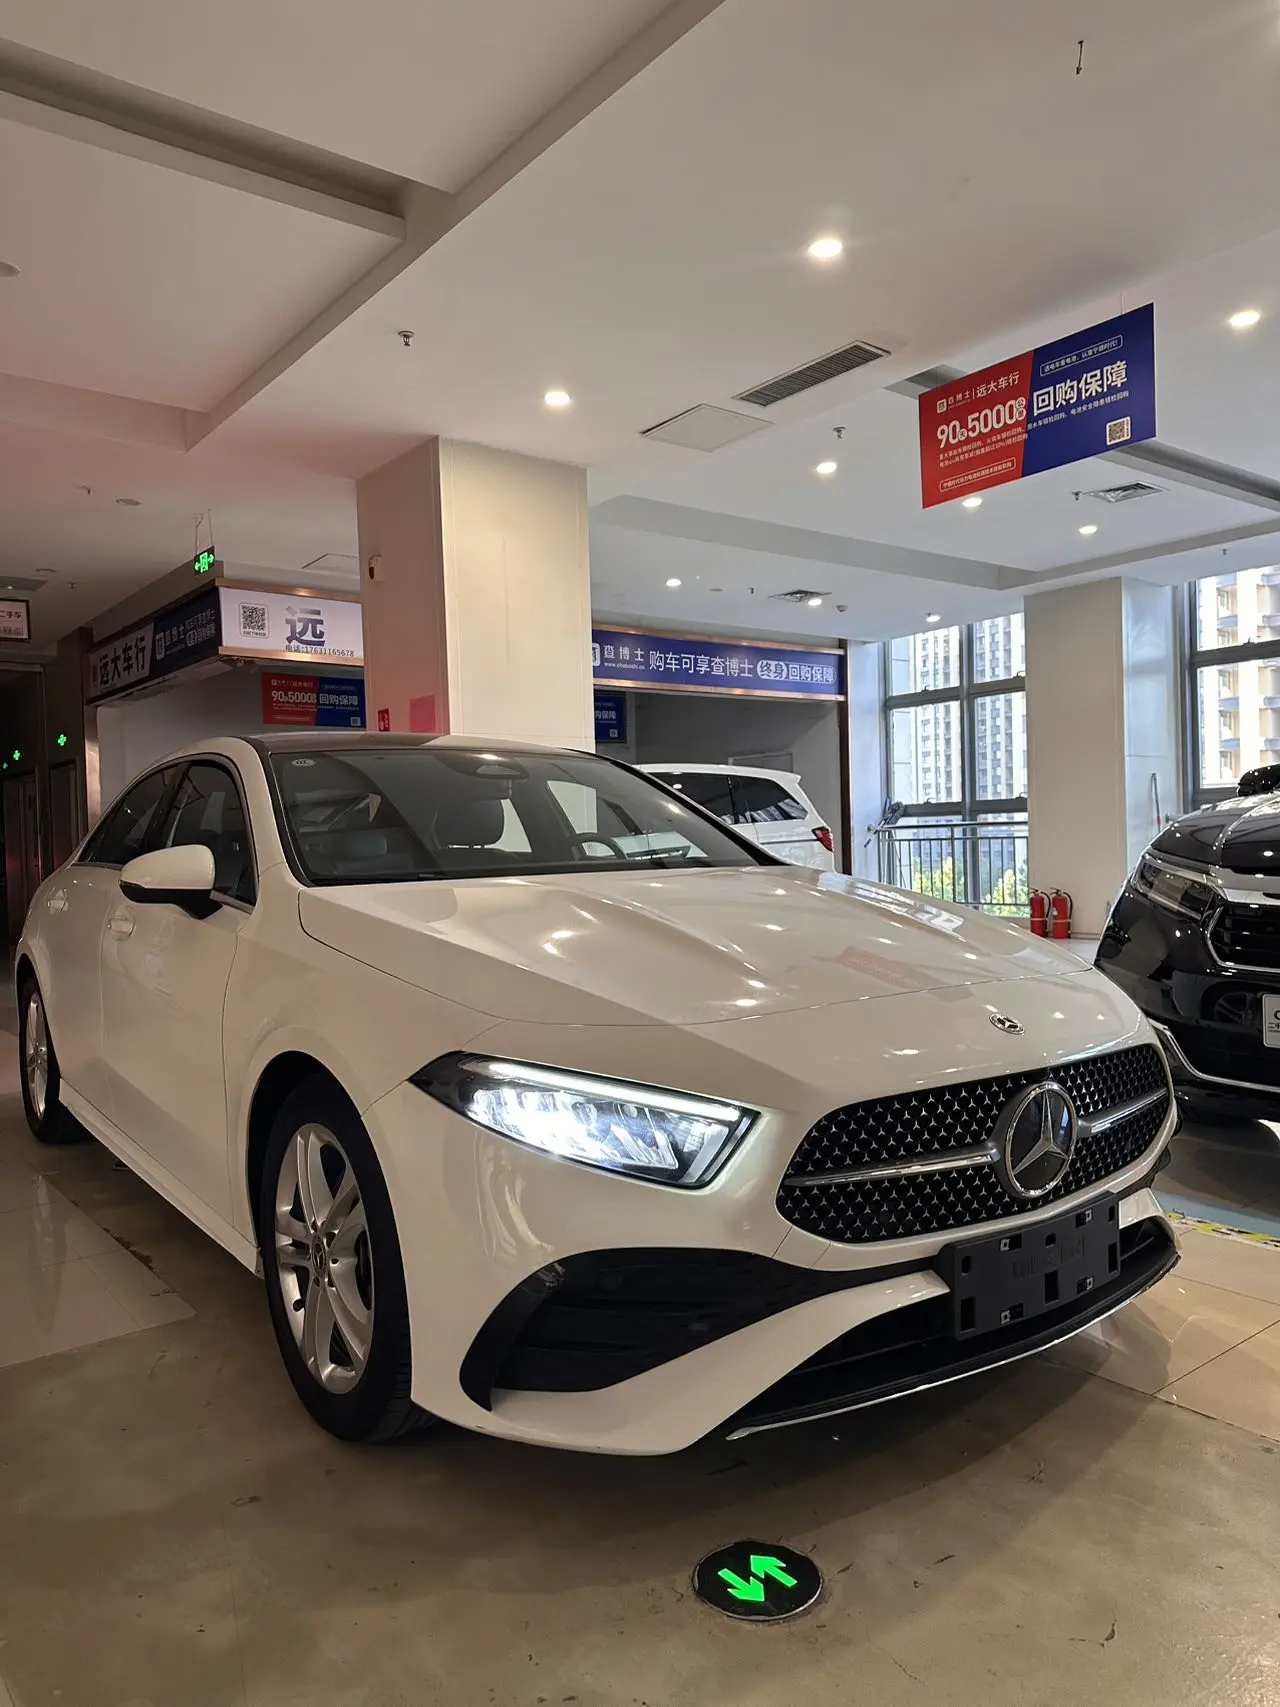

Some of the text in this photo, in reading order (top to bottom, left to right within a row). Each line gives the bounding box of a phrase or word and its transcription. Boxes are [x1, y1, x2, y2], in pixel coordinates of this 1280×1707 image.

[976, 371, 1020, 397] 远大车行
[1033, 360, 1128, 416] 回购保障
[285, 605, 326, 647] 远
[100, 635, 146, 686] 远大车行
[604, 645, 834, 684] 查博士 购车可享查博士 终身 回购保障
